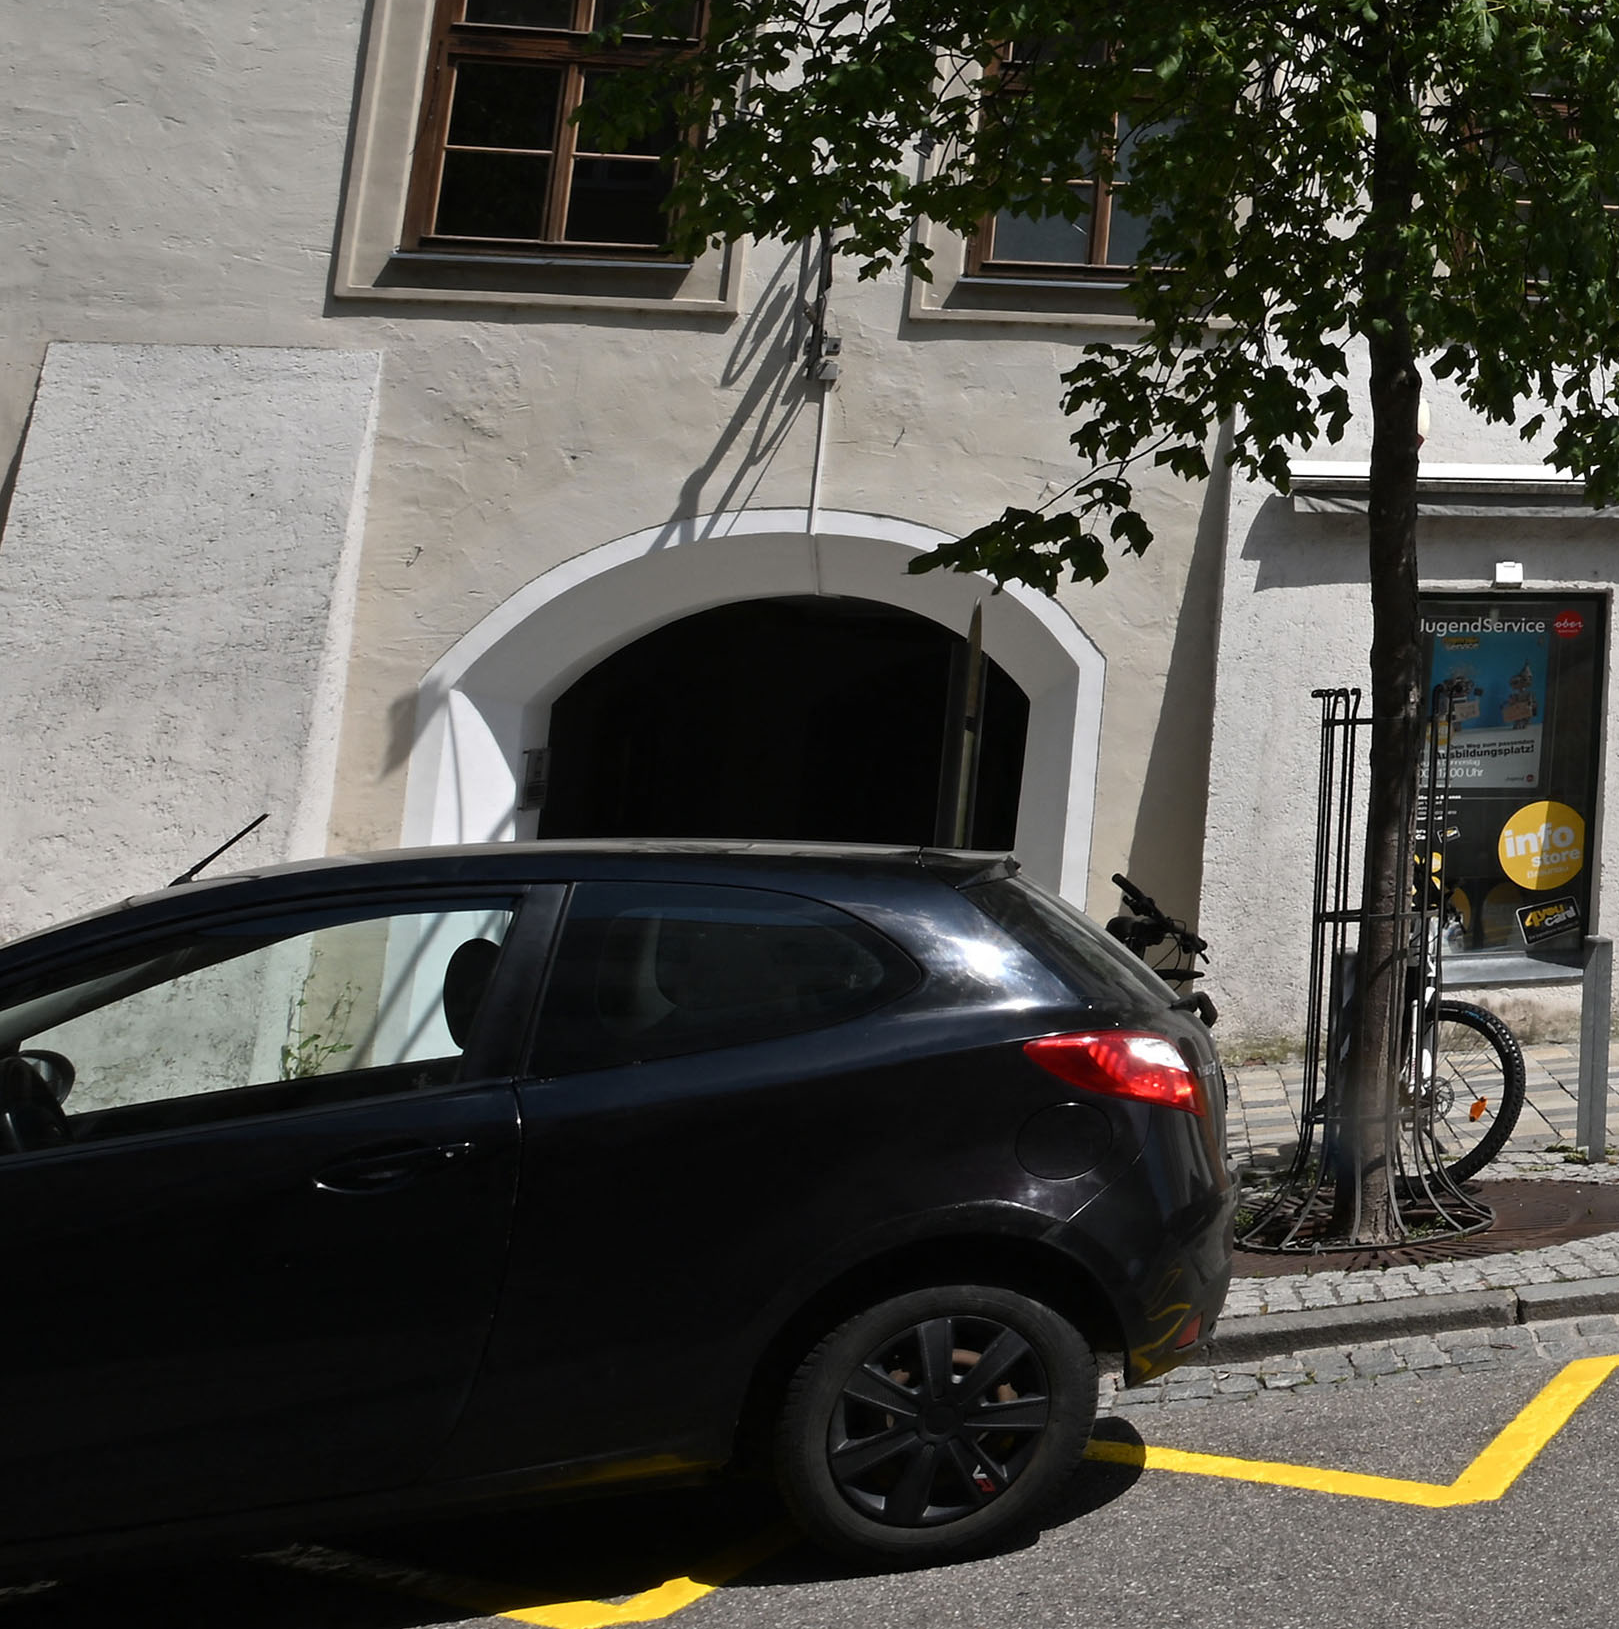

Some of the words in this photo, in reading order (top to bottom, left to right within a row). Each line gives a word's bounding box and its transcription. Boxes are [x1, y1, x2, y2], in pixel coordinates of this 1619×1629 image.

[1420, 618, 1545, 637] JugendService
[1465, 768, 1484, 778] Uhr
[1504, 822, 1575, 859] info
[1531, 848, 1581, 868] store
